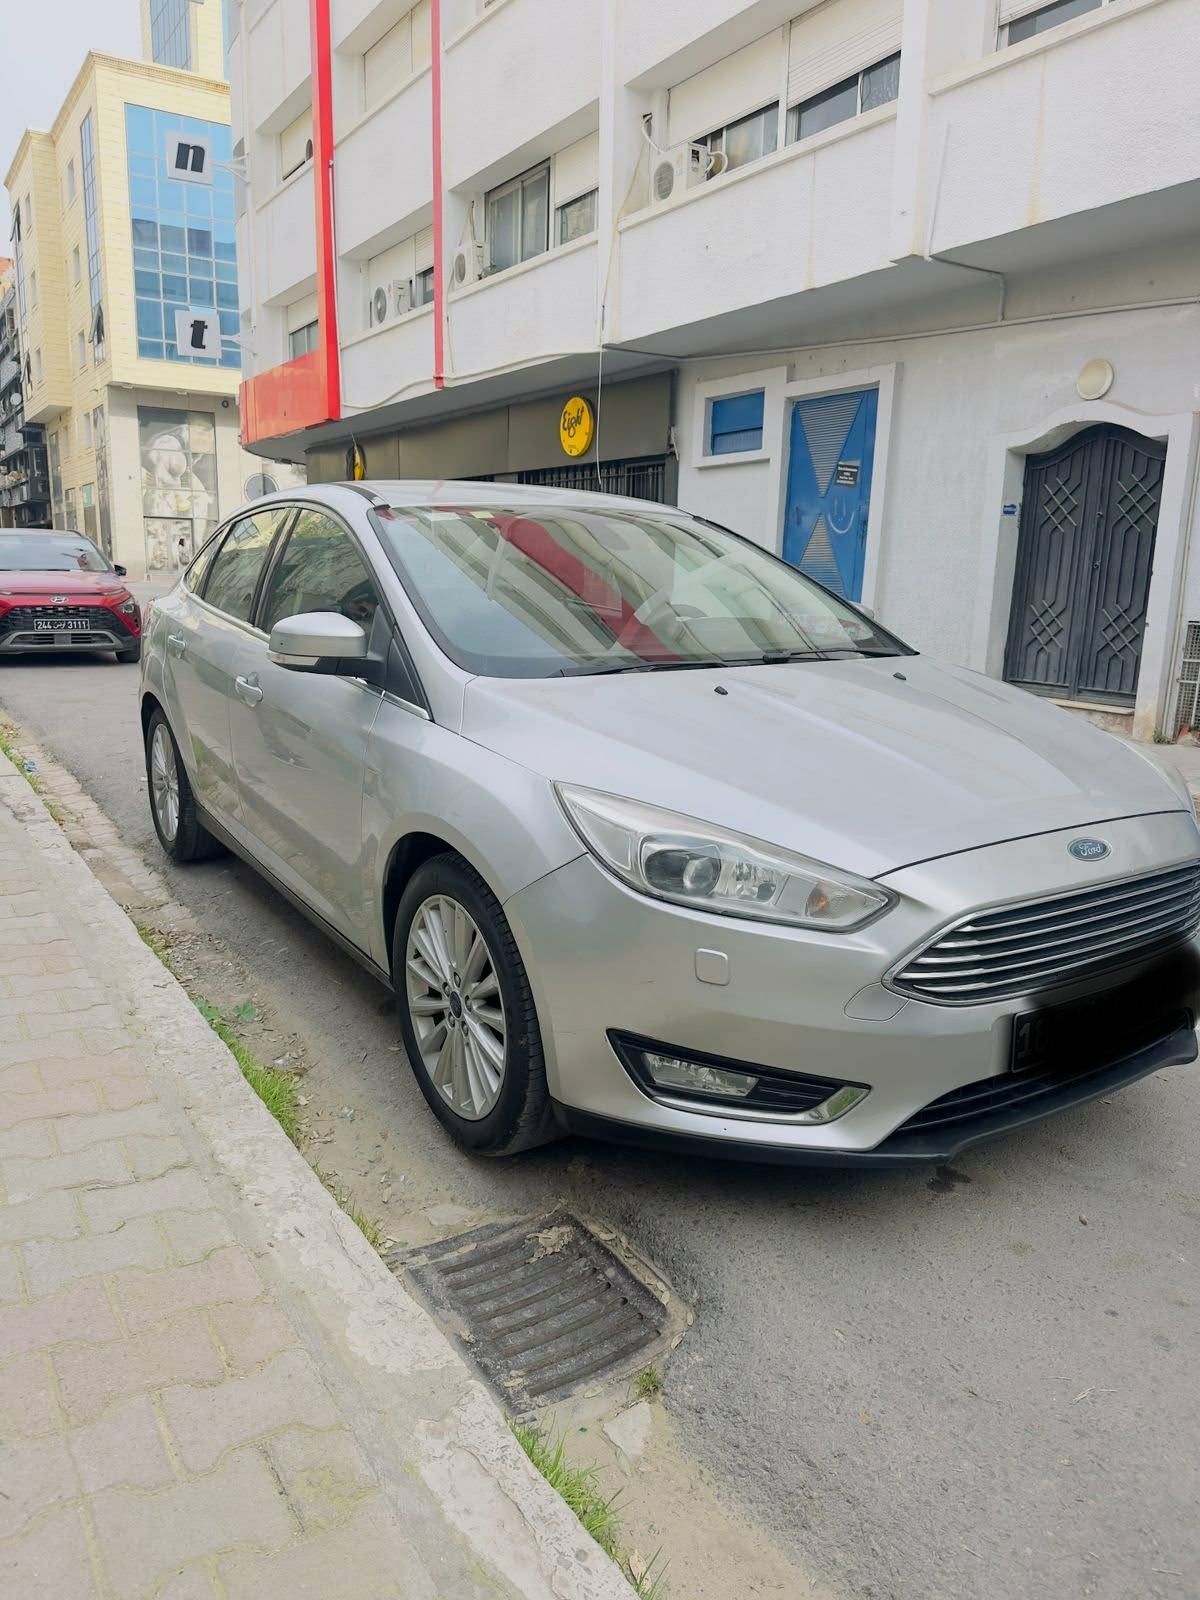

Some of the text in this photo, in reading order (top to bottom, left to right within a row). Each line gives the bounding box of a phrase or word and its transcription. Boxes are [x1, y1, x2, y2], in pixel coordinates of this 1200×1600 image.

[175, 142, 206, 173] n
[190, 320, 208, 349] t
[563, 406, 584, 438] Eight
[37, 621, 52, 630] 244
[67, 621, 86, 629] 3111
[1079, 843, 1101, 856] Ford
